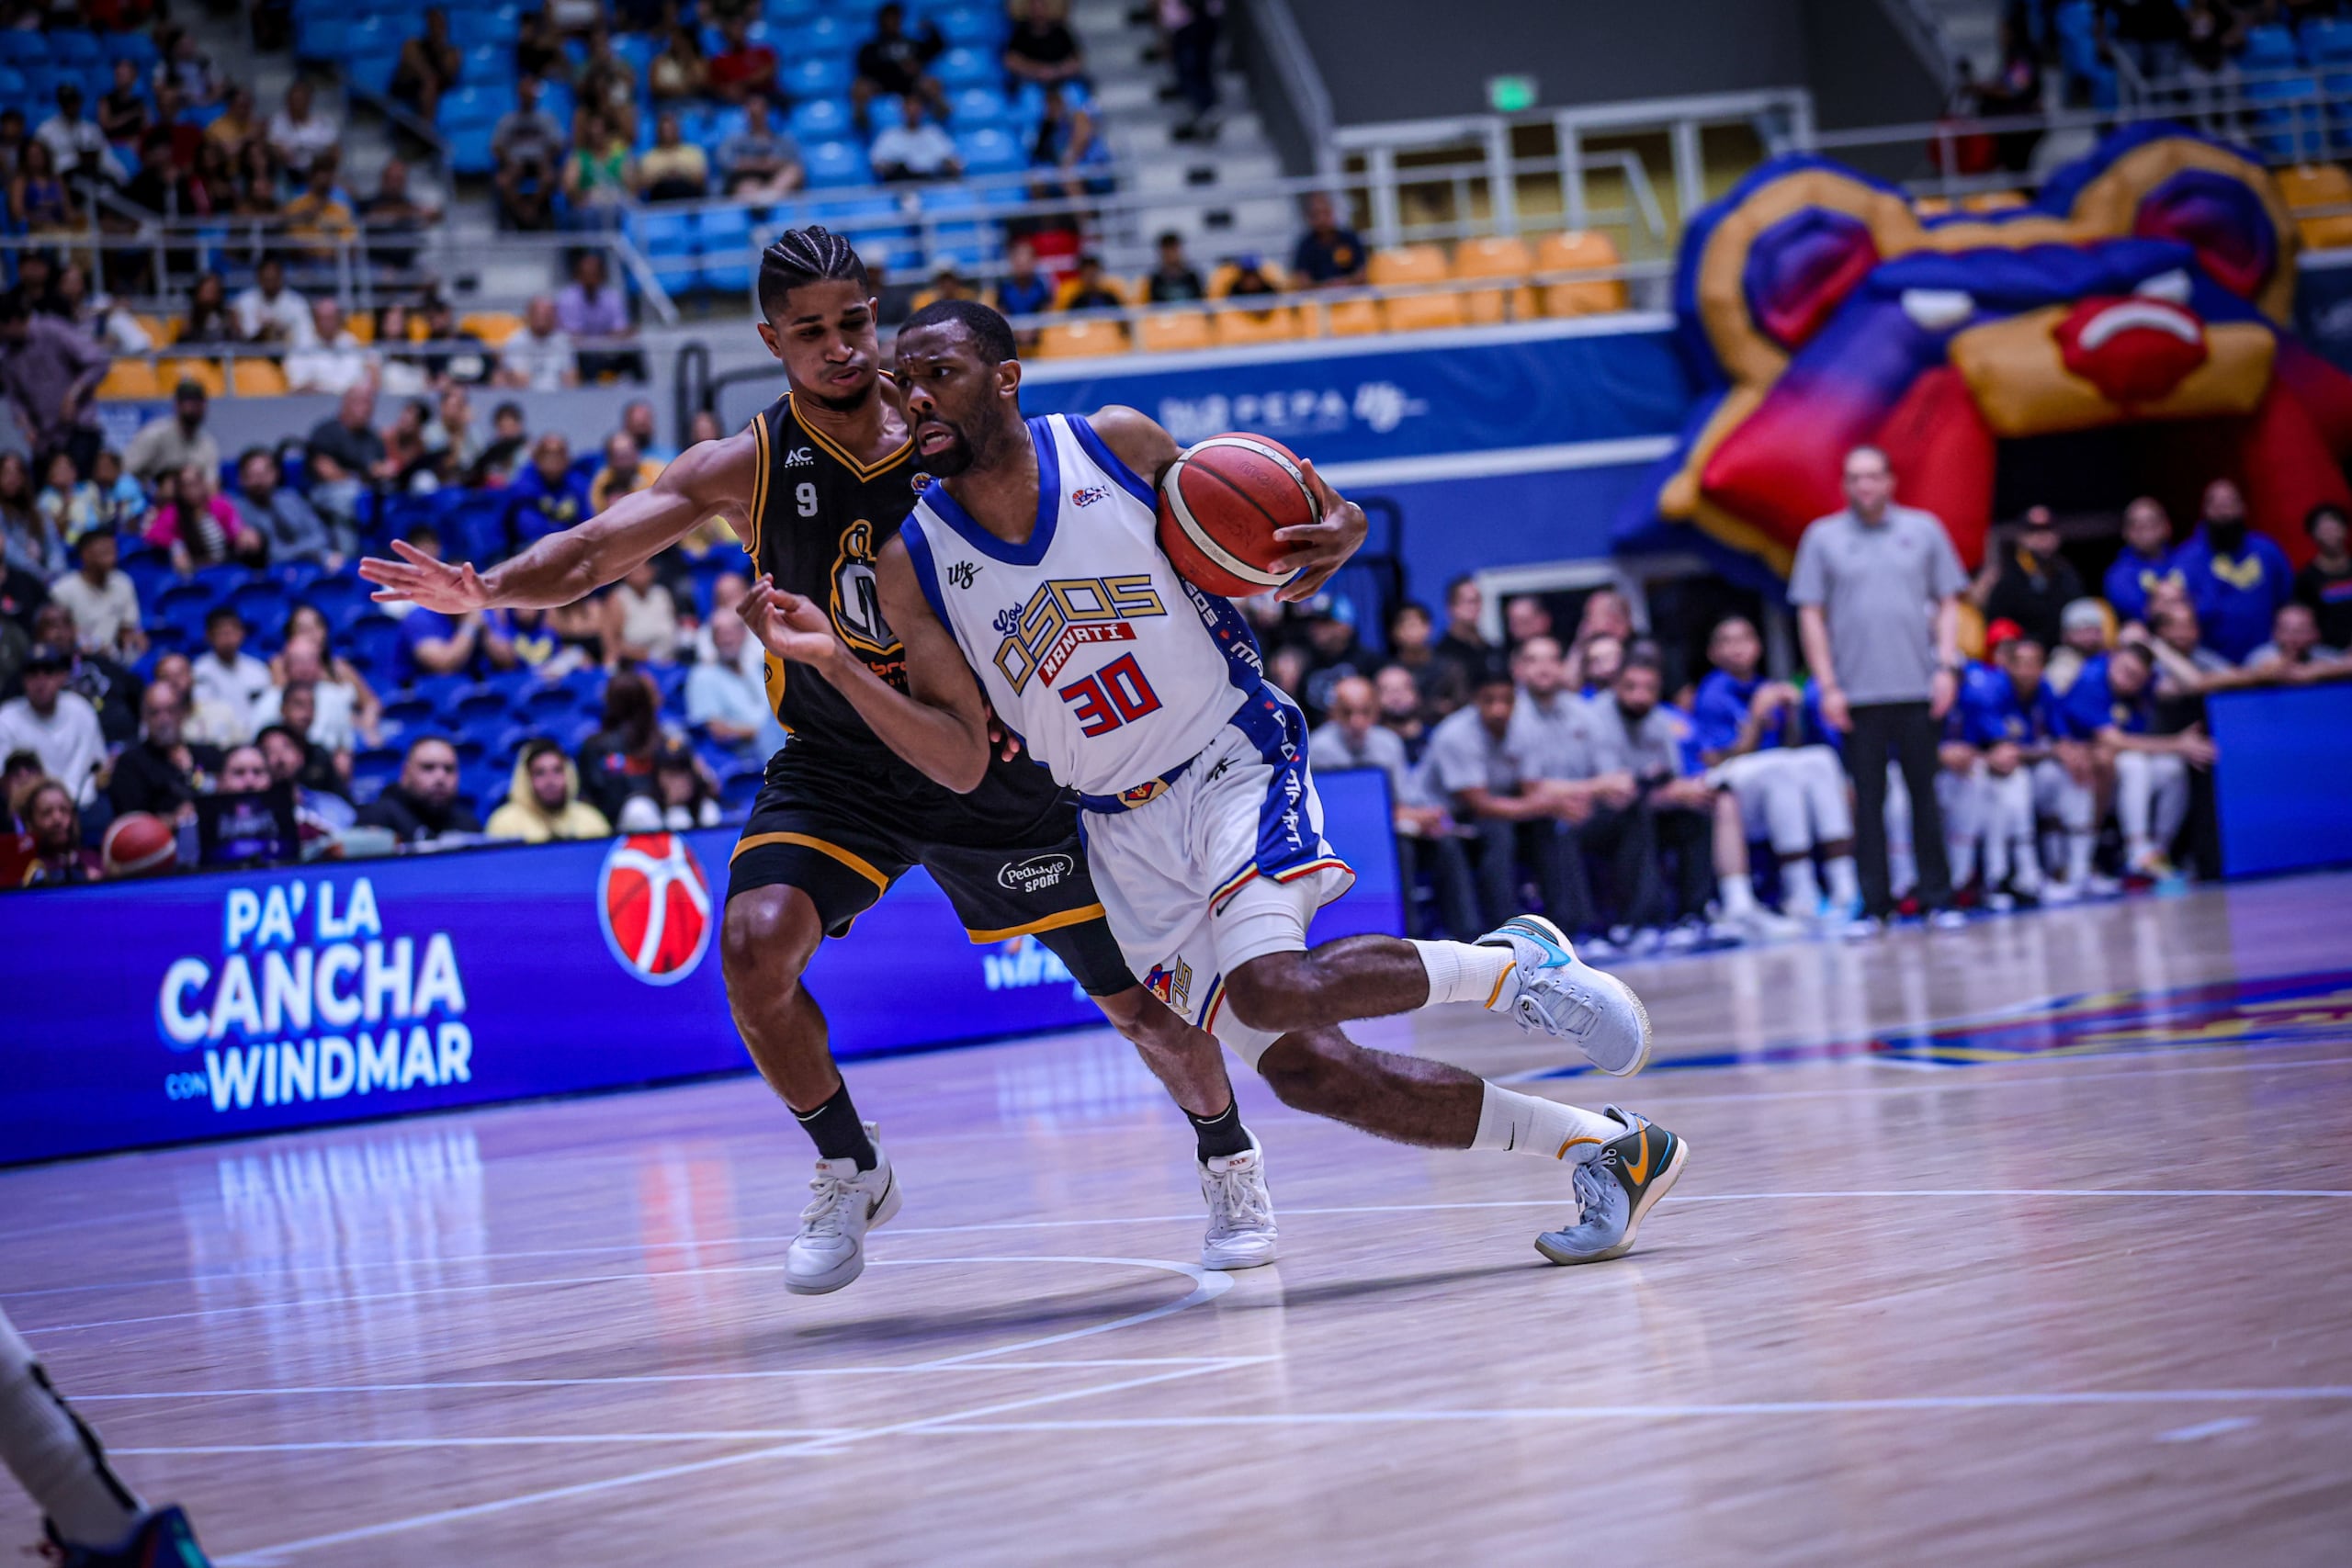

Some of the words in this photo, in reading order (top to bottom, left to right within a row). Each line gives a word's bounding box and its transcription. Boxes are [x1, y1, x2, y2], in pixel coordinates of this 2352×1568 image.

[785, 446, 813, 464] AC
[796, 482, 818, 517] 9
[992, 574, 1168, 698] OSOS
[993, 602, 1023, 636] Los
[1043, 623, 1124, 678] MANATÍ
[1058, 651, 1163, 739] 30
[225, 879, 307, 951] PA'
[316, 876, 381, 939] LA
[1024, 874, 1060, 893] SPORT
[159, 932, 466, 1047] CANCHA
[205, 1021, 473, 1112] WINDMAR
